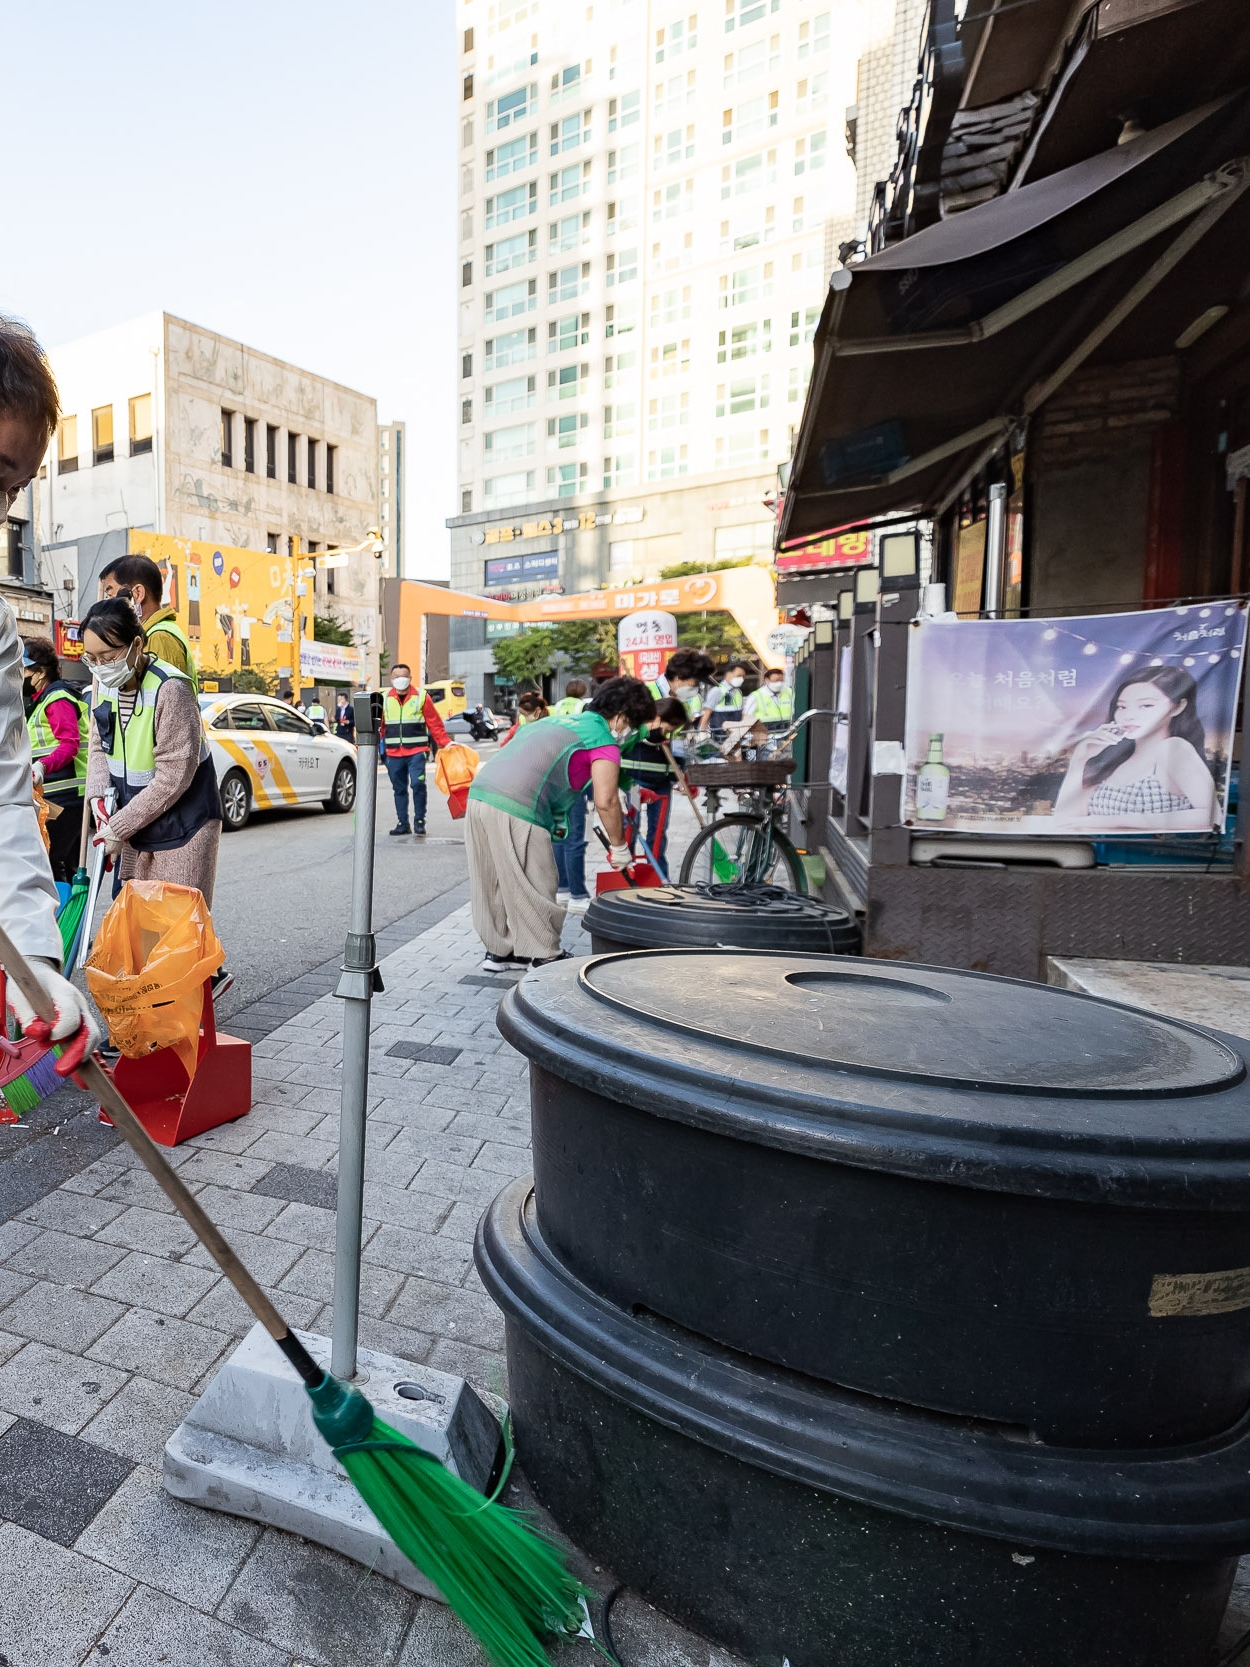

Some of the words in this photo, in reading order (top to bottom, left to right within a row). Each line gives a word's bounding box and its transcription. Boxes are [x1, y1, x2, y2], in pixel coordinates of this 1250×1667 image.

[615, 589, 681, 609] 미가로
[625, 637, 649, 647] 24시
[654, 634, 673, 645] 영업
[994, 668, 1077, 688] 처음처럼
